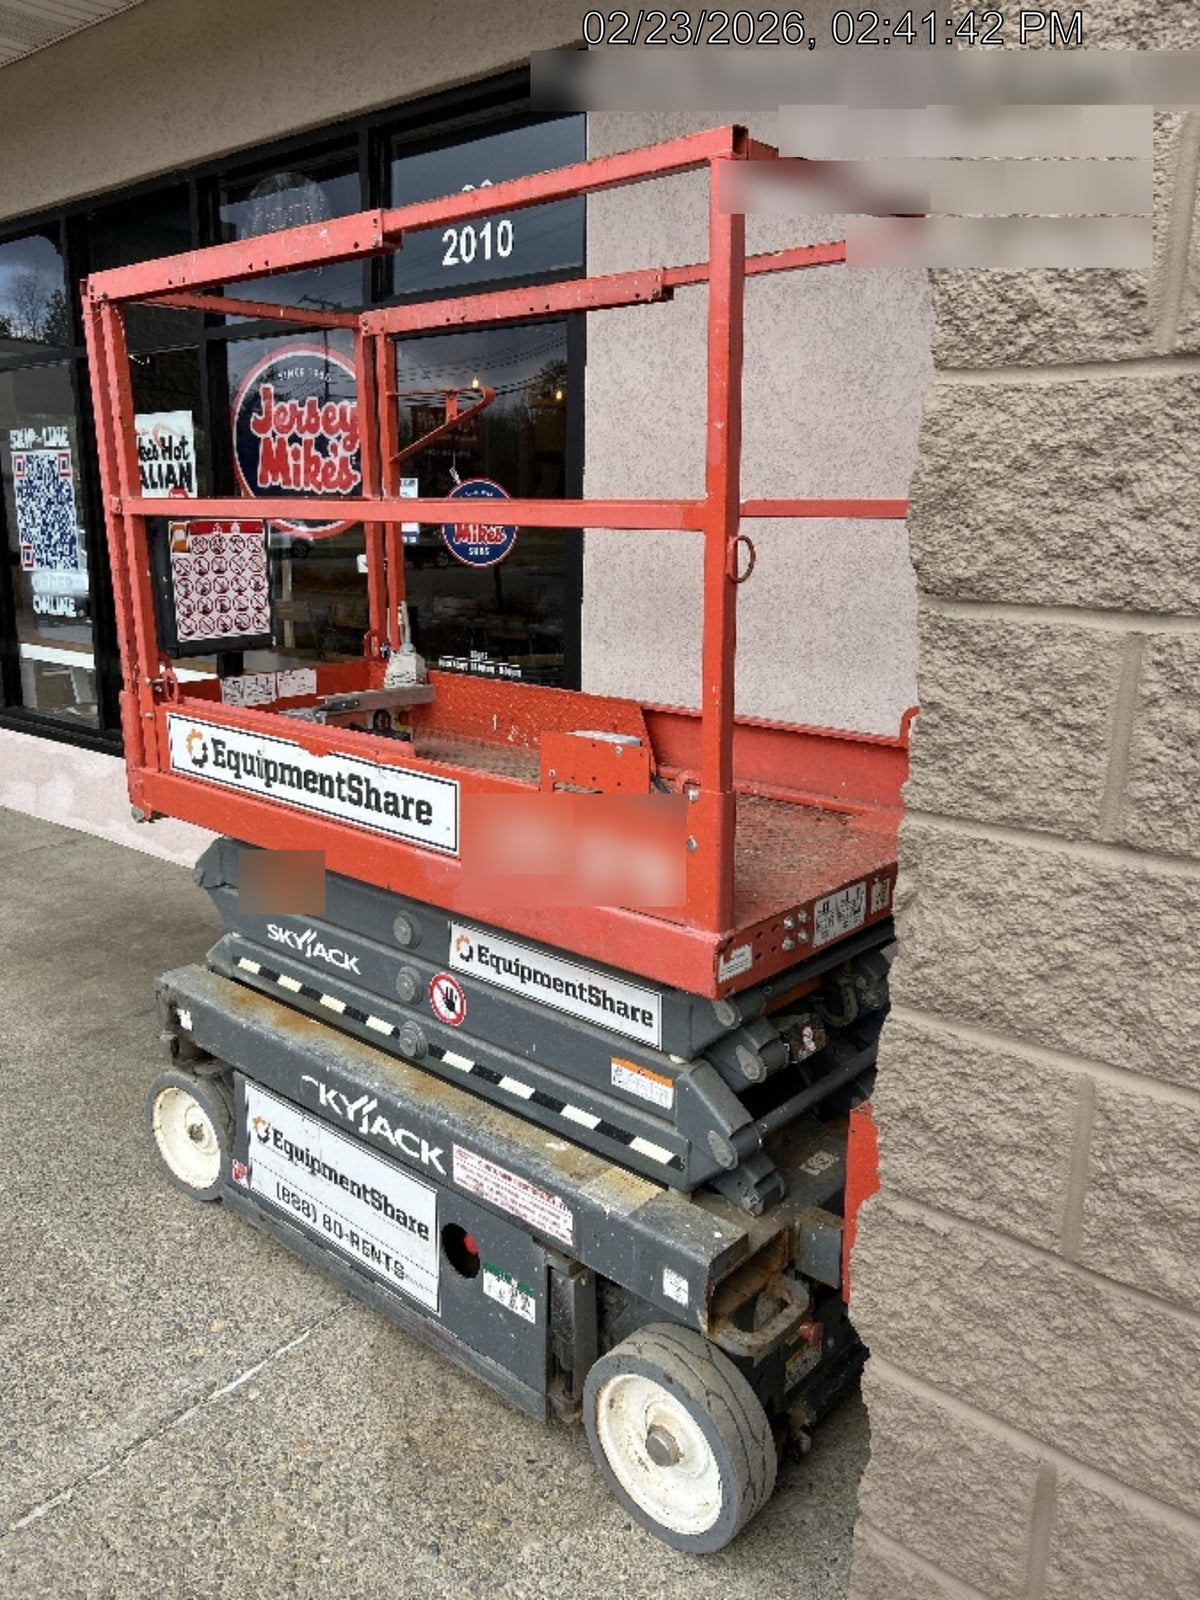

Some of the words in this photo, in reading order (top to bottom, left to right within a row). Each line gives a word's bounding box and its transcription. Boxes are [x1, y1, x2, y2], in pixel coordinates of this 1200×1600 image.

[442, 219, 513, 266] 2010
[159, 435, 191, 460] Hot
[250, 383, 361, 454] Jersey
[257, 436, 362, 494] Mike's
[210, 736, 433, 826] EquipmentShare
[266, 922, 362, 976] SKYJACK
[477, 943, 654, 1028] EquipmentShare
[272, 1127, 430, 1242] EquipmentShare
[276, 1180, 318, 1224] (888)
